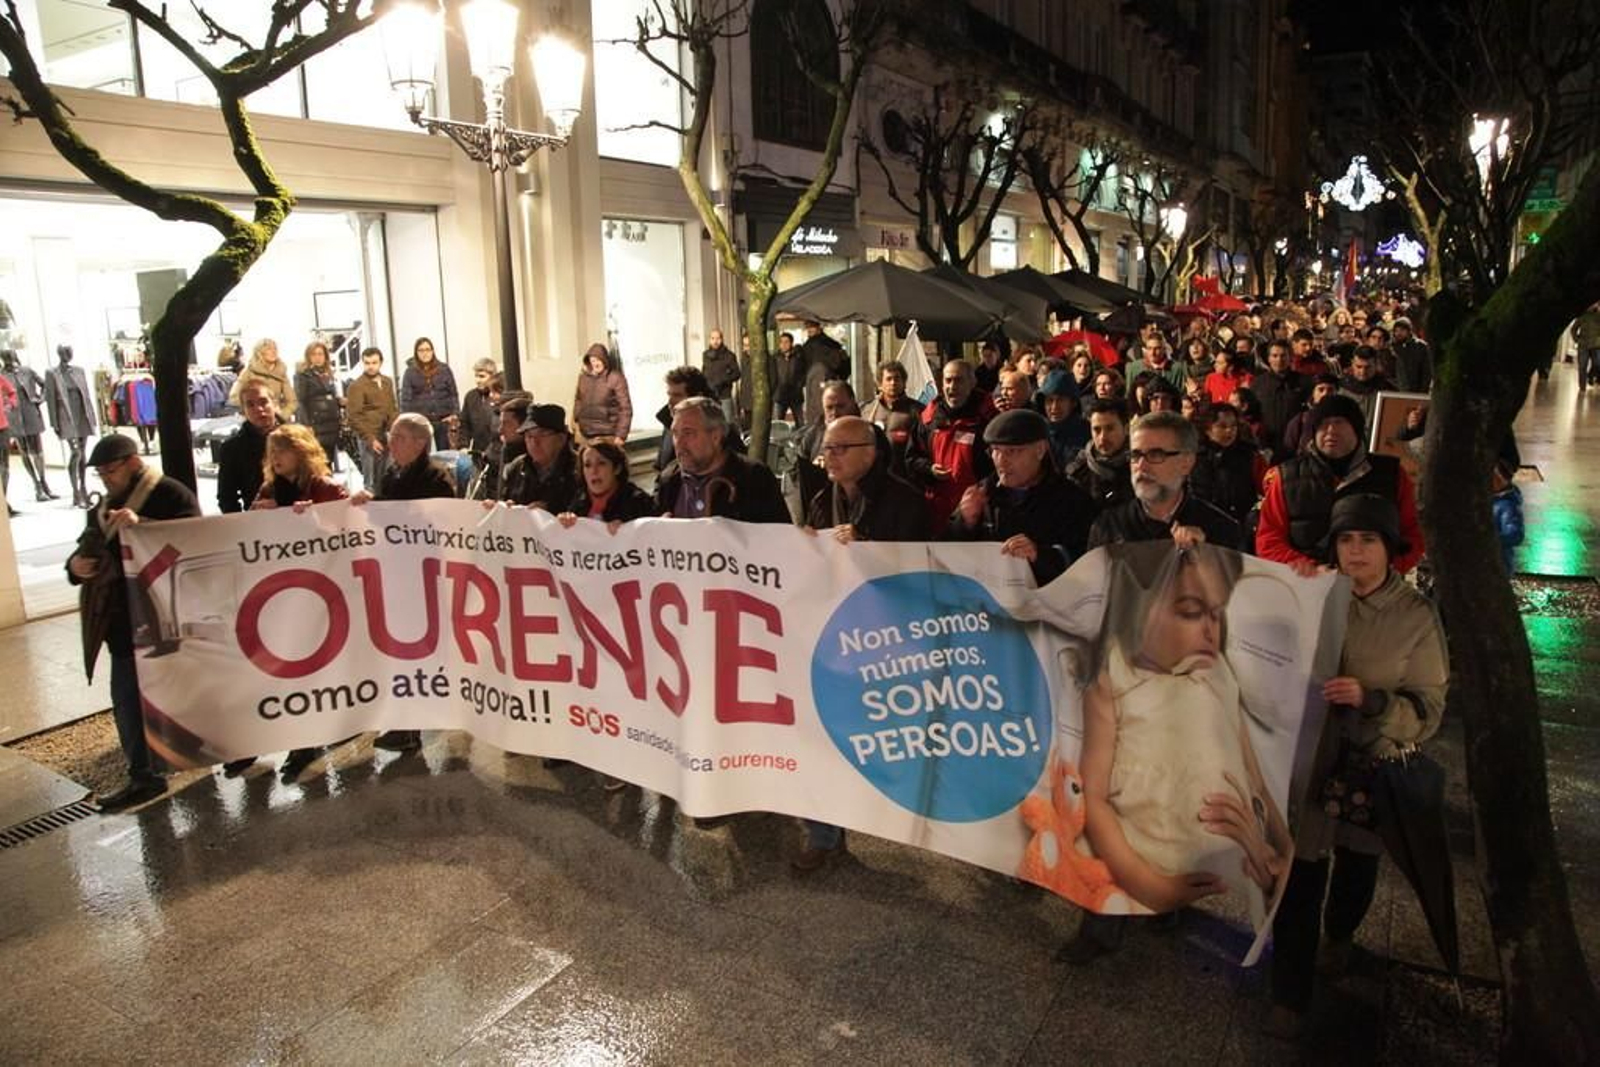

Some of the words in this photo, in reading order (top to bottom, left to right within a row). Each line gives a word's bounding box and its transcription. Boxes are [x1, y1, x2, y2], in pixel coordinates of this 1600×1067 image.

[238, 526, 376, 563] Urxencias
[483, 530, 514, 553] das
[572, 548, 642, 571] nenas
[647, 547, 656, 567] e
[661, 548, 739, 576] nenos
[745, 563, 782, 589] en
[235, 556, 796, 726] OURENSE
[837, 624, 904, 656] Non
[908, 611, 990, 641] somos
[858, 645, 987, 683] números.
[257, 679, 379, 720] como
[392, 666, 450, 698] até
[460, 676, 552, 724] agora!!
[861, 674, 1004, 721] SOMOS
[719, 753, 798, 772] ourense
[849, 716, 1041, 765] PERSOAS!
